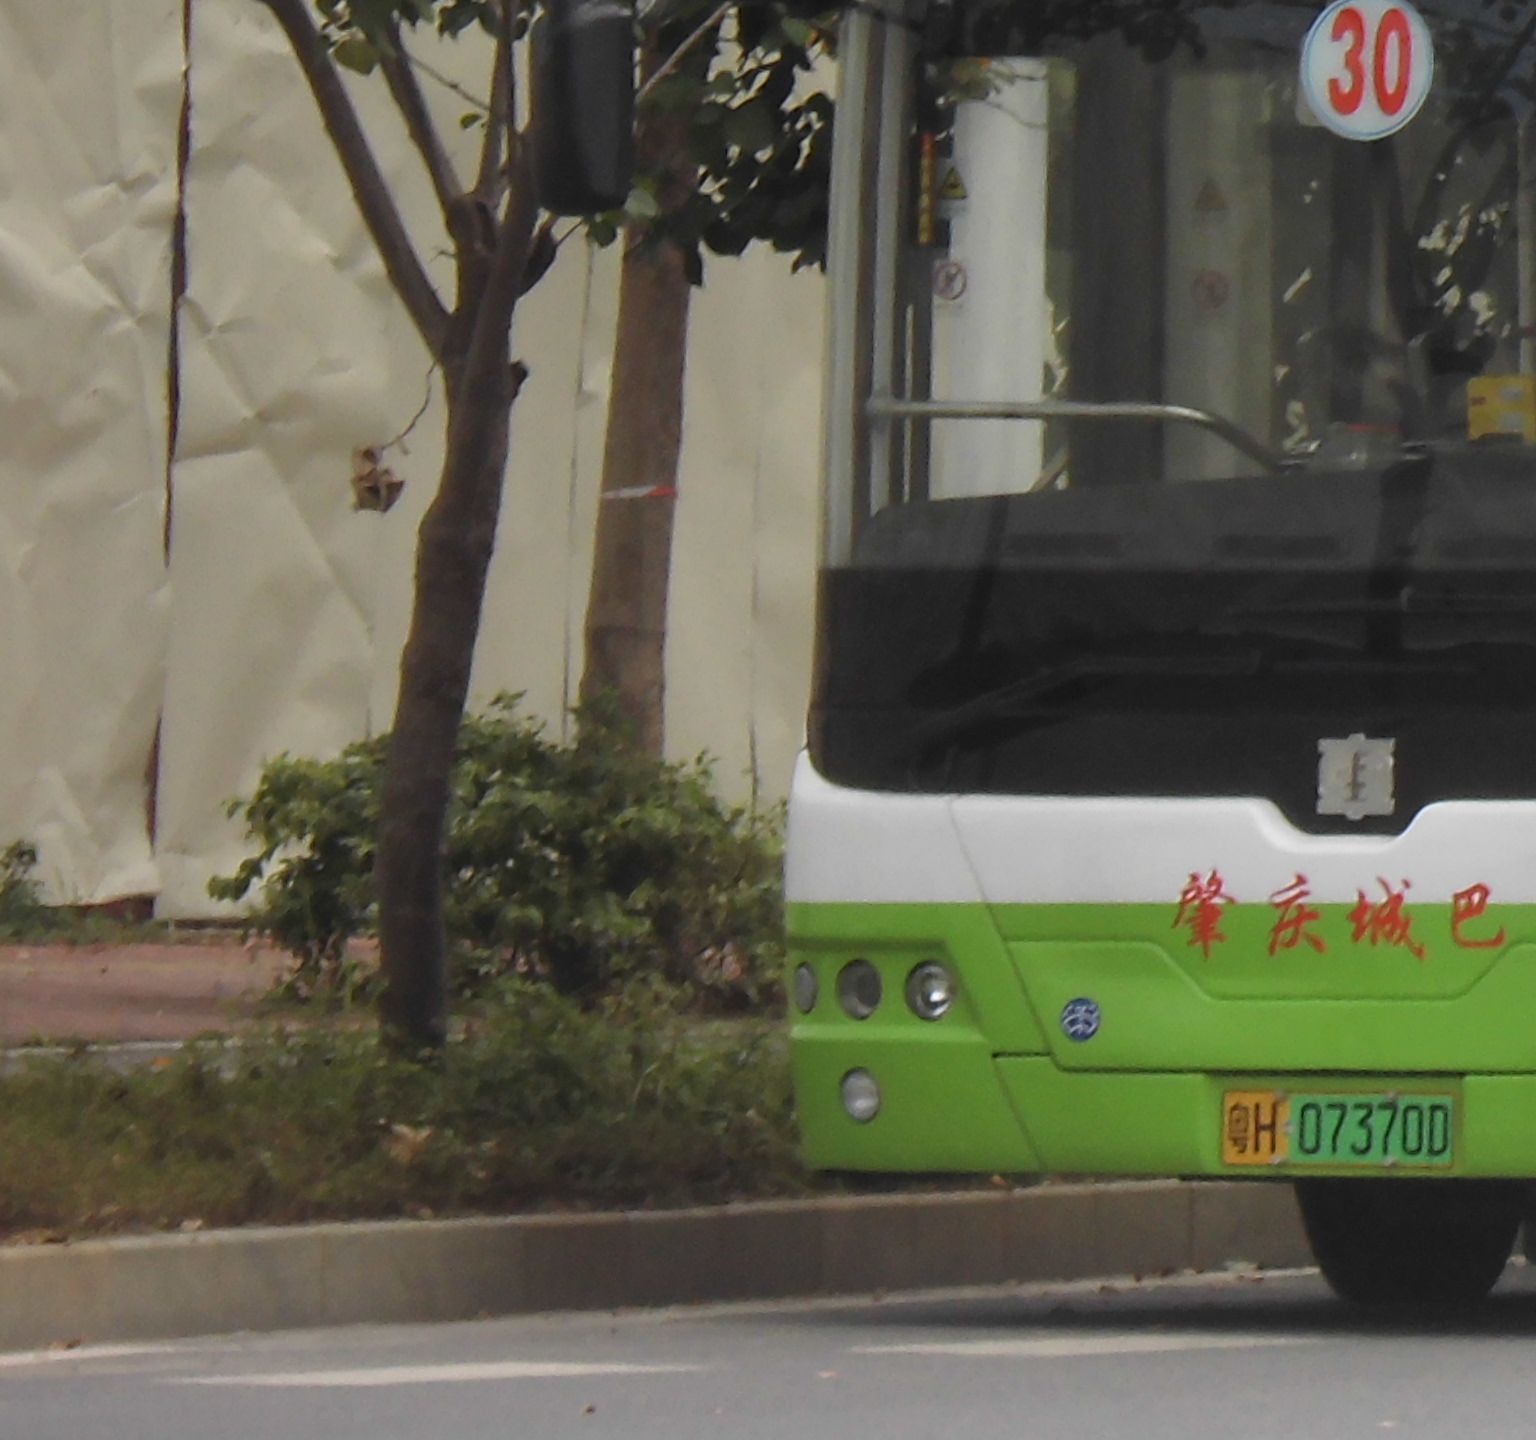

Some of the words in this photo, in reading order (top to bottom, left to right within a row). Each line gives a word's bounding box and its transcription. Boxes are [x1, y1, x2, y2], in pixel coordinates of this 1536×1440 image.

[1327, 6, 1413, 117] 30
[1171, 868, 1506, 961] 肇庆城巴
